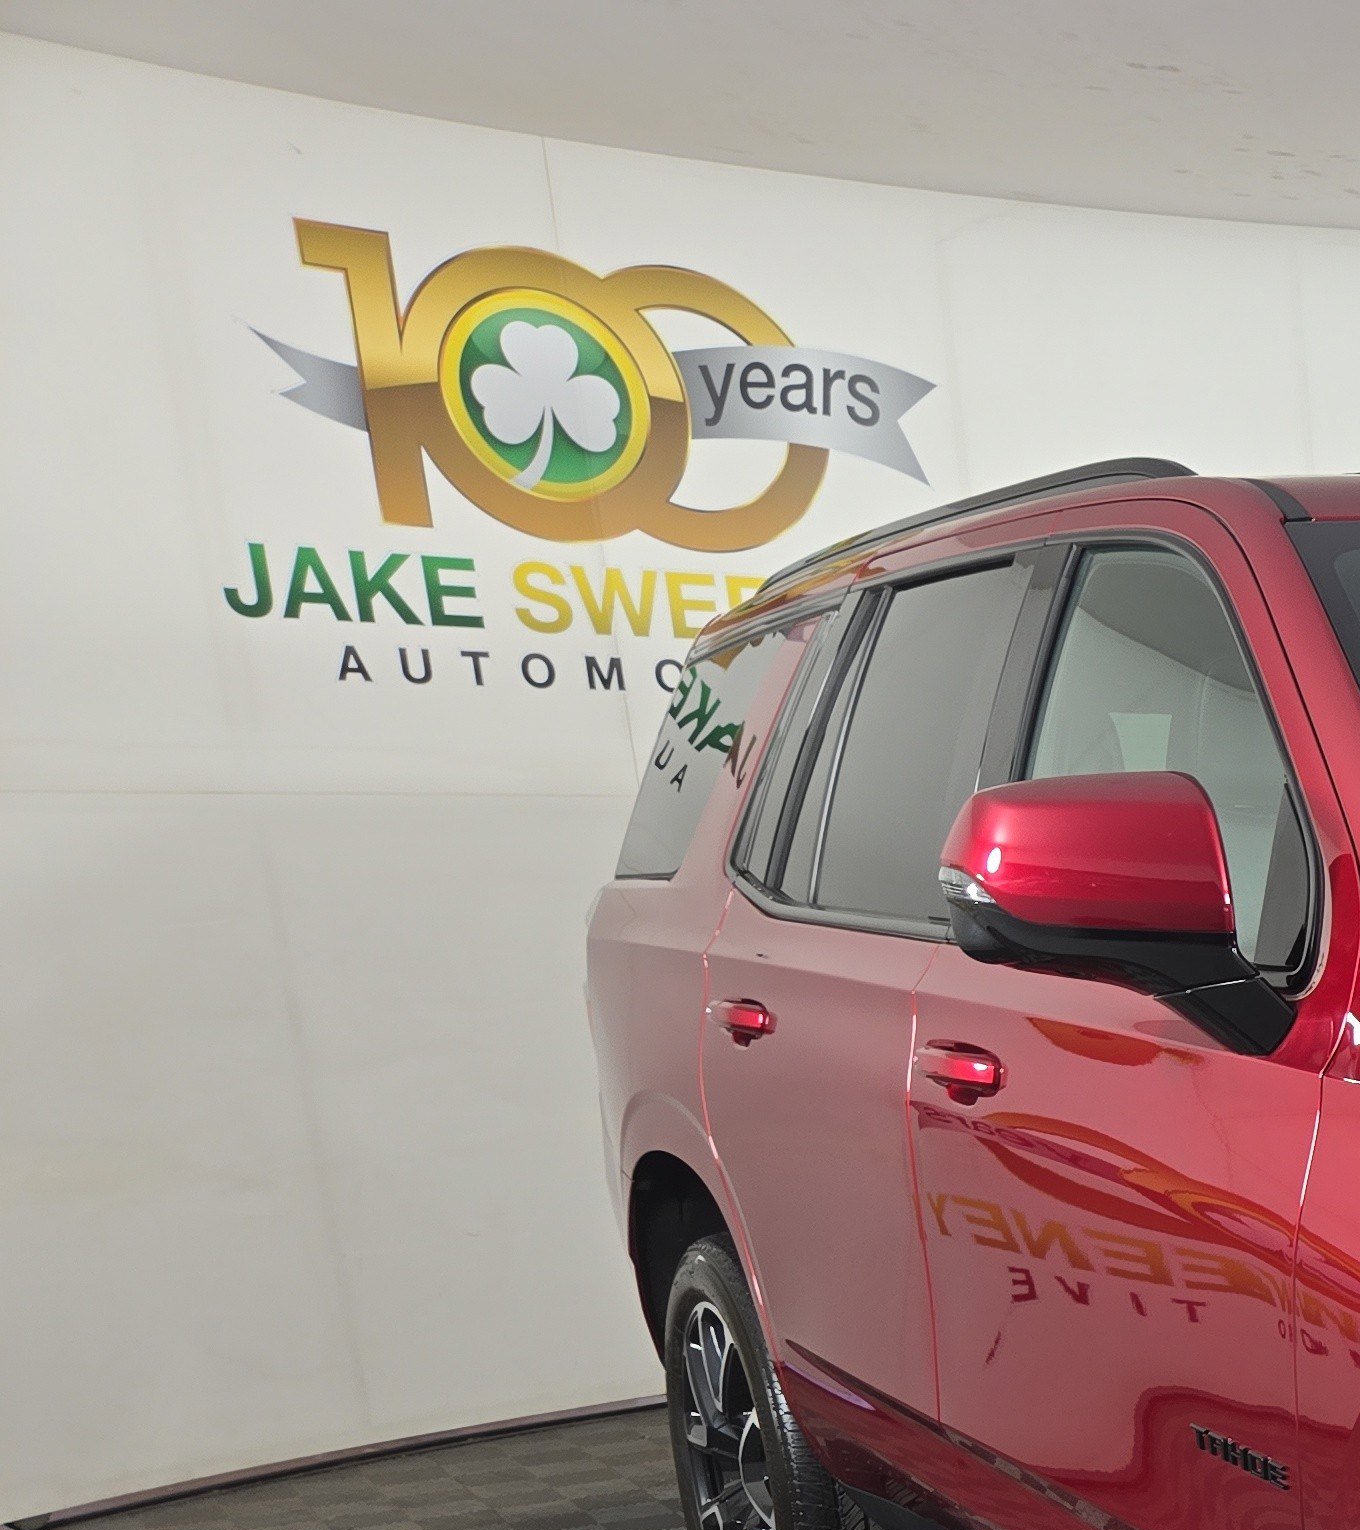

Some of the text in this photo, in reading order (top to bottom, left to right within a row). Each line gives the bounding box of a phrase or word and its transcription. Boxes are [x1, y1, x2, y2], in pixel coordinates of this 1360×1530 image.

[698, 360, 882, 428] years
[223, 542, 485, 629] JAKE
[337, 645, 684, 692] AUTOMO
[1190, 1423, 1291, 1491] TAHOE
